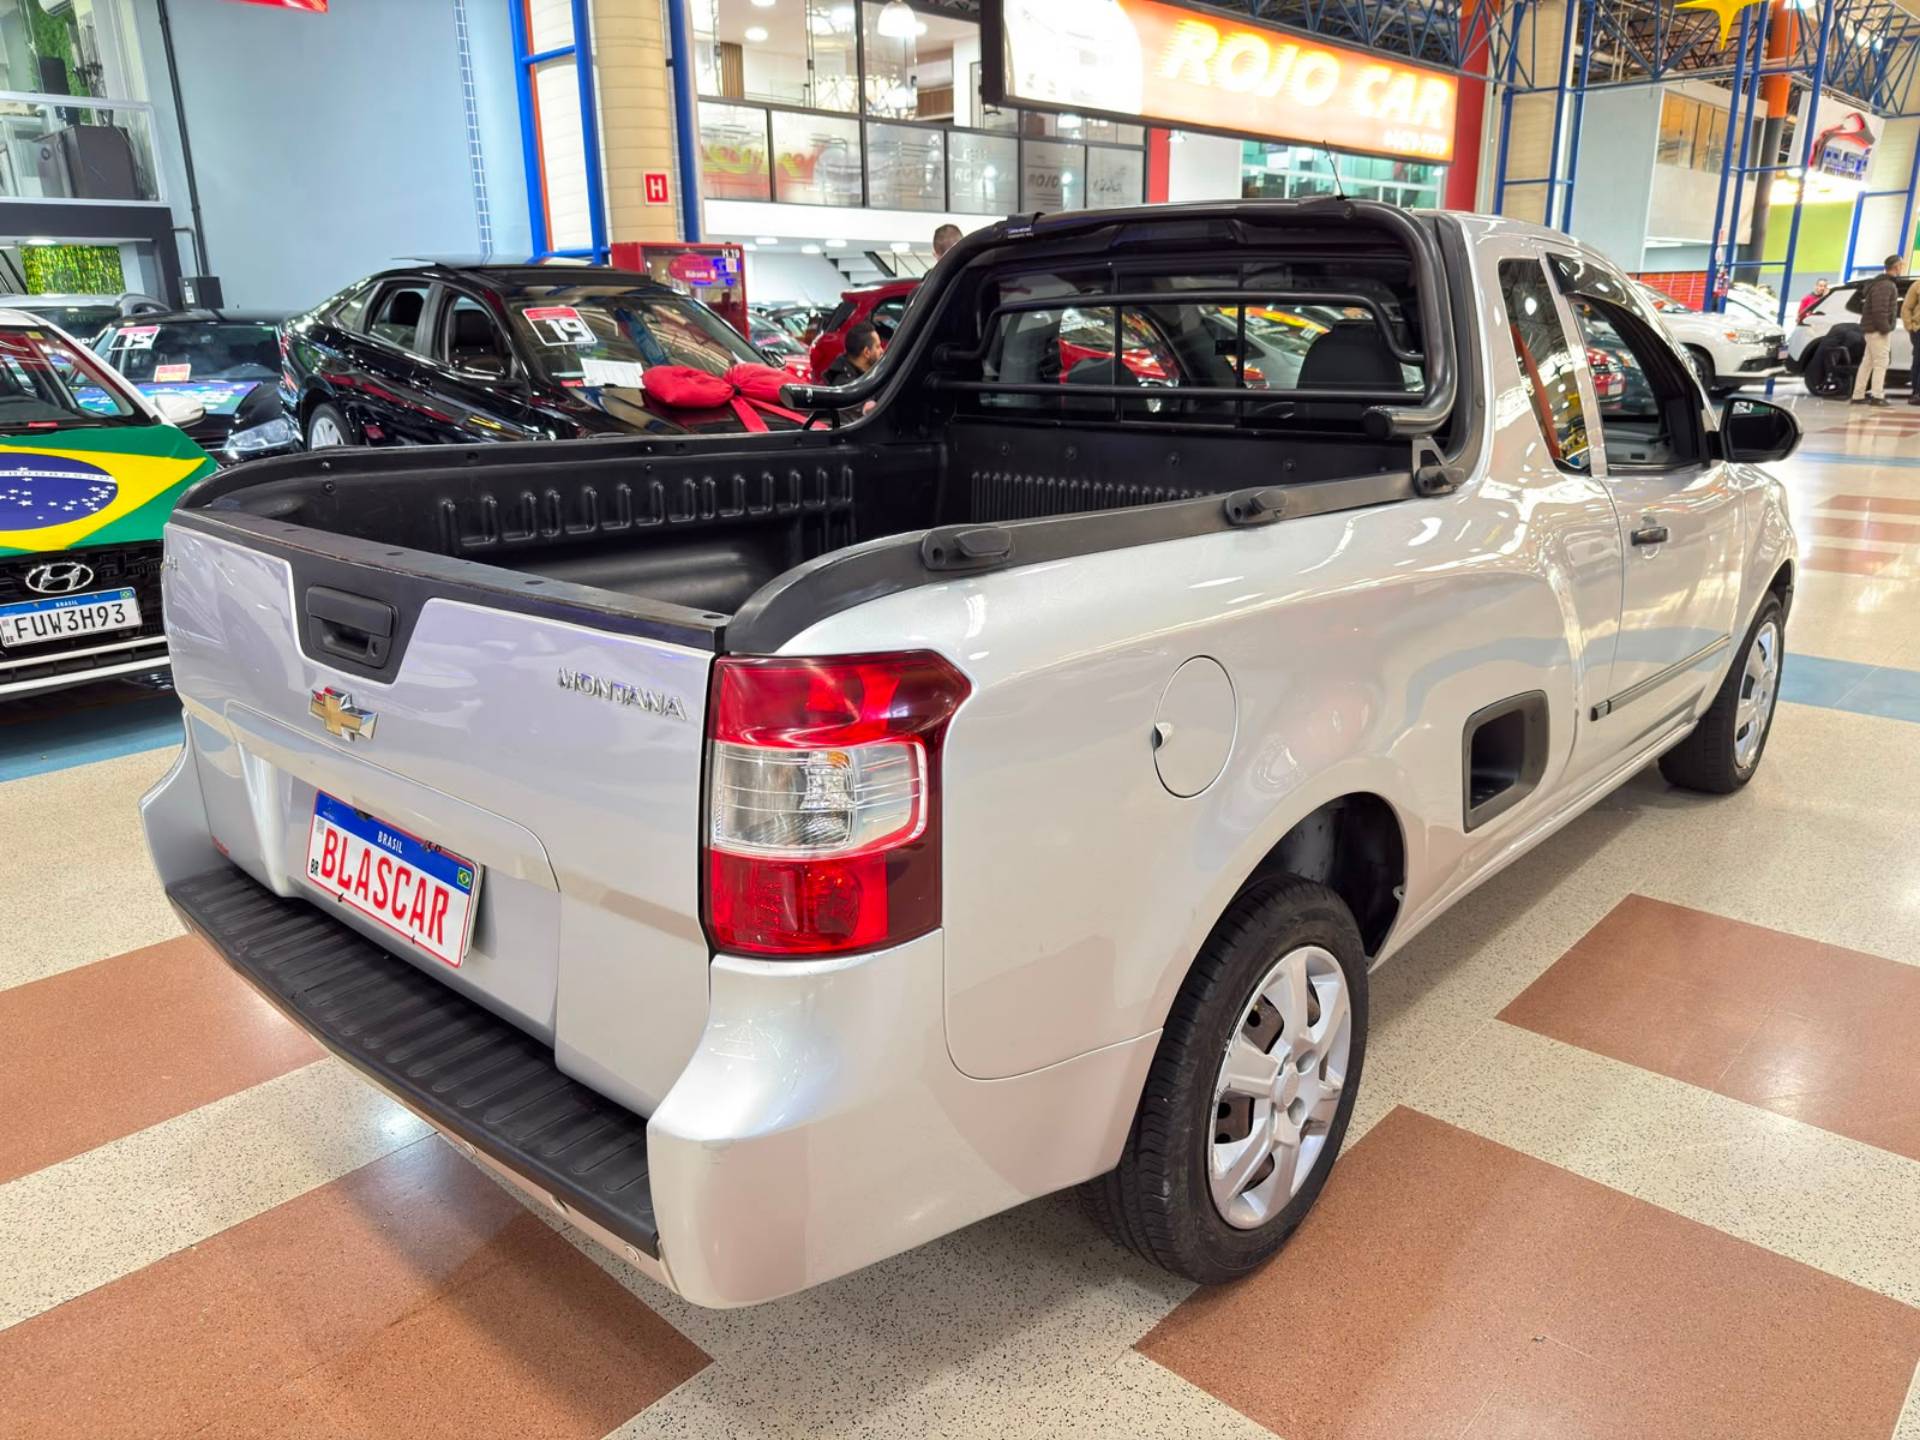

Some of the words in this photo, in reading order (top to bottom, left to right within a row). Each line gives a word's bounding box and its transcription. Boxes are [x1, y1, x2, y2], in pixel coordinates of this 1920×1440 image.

[1158, 19, 1340, 108] ROJO
[1352, 64, 1450, 130] CAR
[649, 178, 663, 199] H
[124, 333, 151, 349] 15
[545, 318, 594, 342] 19
[14, 603, 126, 639] FUW3H93
[558, 666, 687, 721] MONTANA
[377, 830, 403, 854] BRASIL
[310, 857, 319, 876] BR
[320, 827, 450, 945] BLASCAR
